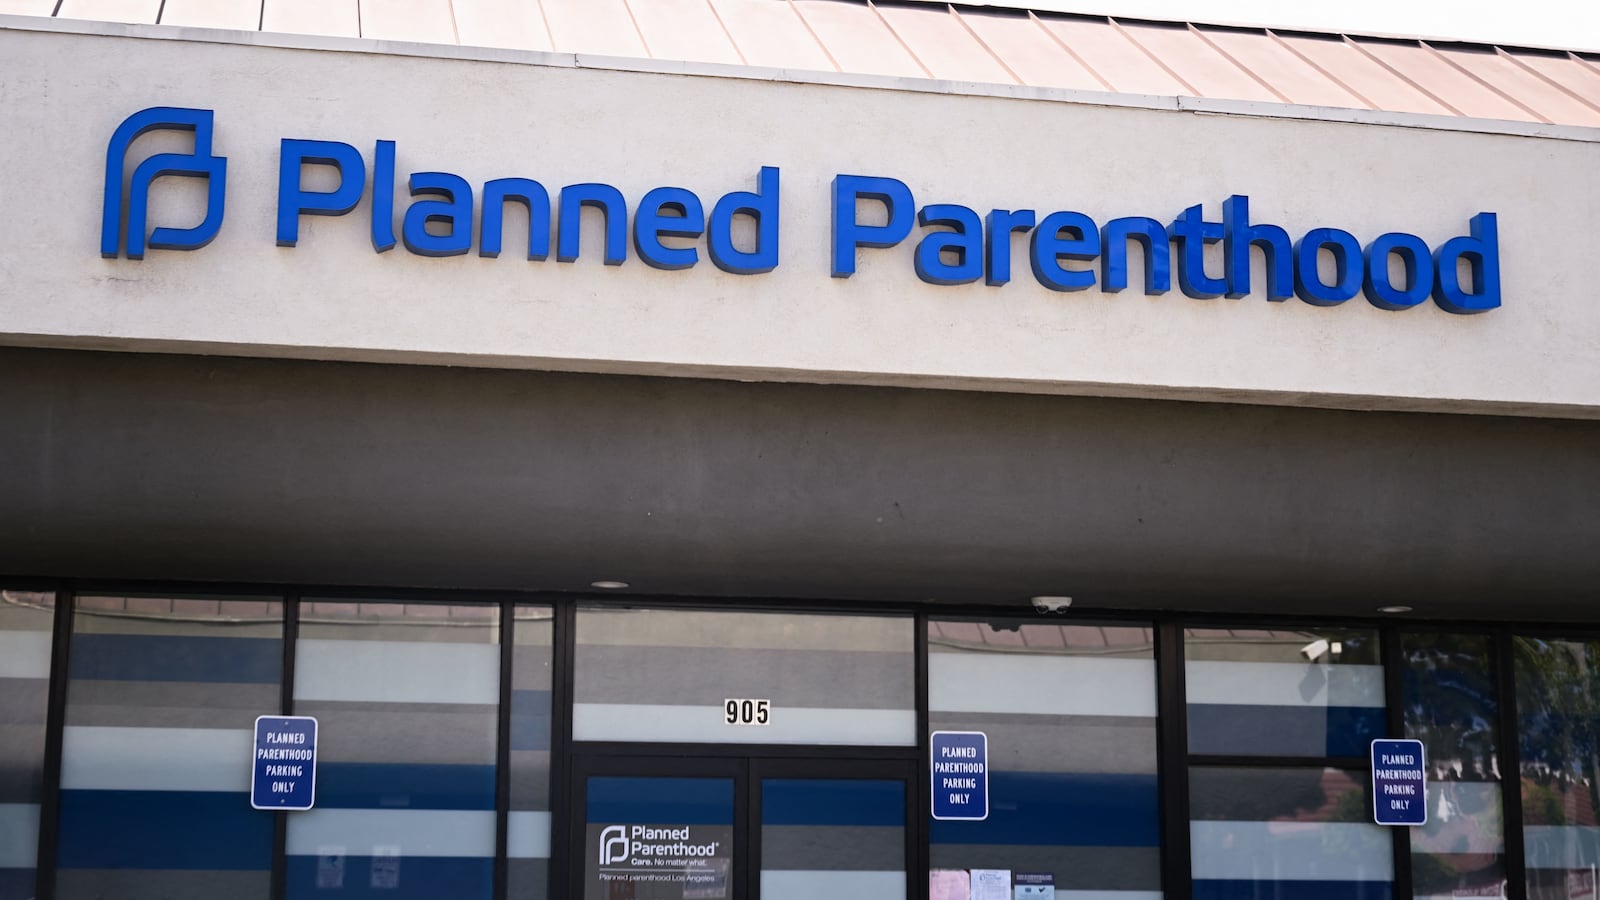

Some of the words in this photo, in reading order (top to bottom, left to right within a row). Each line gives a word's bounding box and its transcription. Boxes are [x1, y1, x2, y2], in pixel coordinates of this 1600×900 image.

[276, 138, 780, 275] Planned
[830, 174, 1503, 315] Parenthood
[726, 700, 769, 724] 905
[266, 732, 305, 744] PLANNED
[257, 748, 313, 761] PARENTHOOD
[942, 746, 977, 758] PLANNED
[1381, 754, 1415, 765] PLANNED
[265, 765, 303, 777] PARKING
[935, 762, 984, 774] PARENTHOOD
[1375, 769, 1422, 780] PARENTHOOD
[272, 781, 295, 793] ONLY
[943, 778, 976, 789] PARKING
[1384, 784, 1415, 795] PARKING
[949, 793, 970, 805] ONLY
[1390, 799, 1410, 810] ONLY
[631, 825, 690, 841] Planned
[631, 841, 715, 857] Parenthood
[631, 857, 654, 866] Care.
[654, 858, 665, 866] No
[665, 858, 688, 866] matter
[599, 873, 629, 881] Planned
[629, 873, 672, 883] parenthood
[686, 874, 716, 883] Angeles
